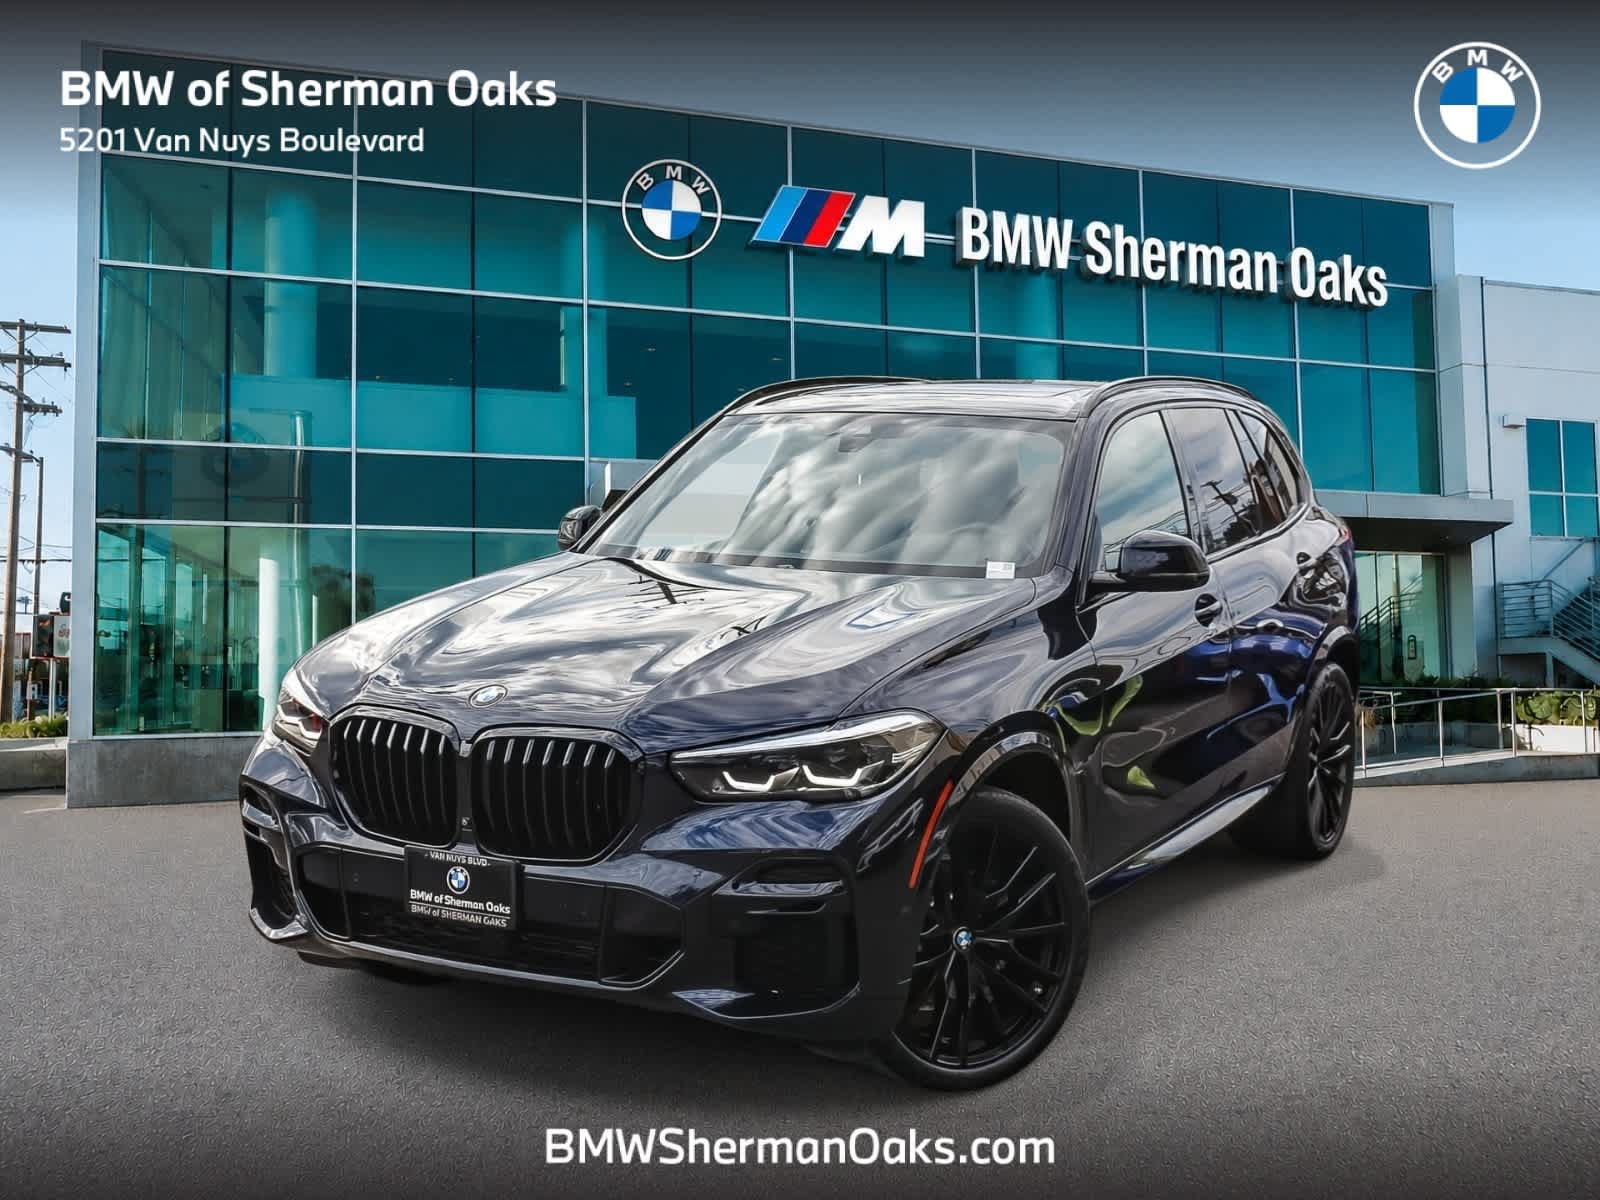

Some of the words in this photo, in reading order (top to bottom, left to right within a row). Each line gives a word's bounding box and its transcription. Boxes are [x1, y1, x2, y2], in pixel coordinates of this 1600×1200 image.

[636, 165, 711, 195] BMW
[833, 195, 925, 258] M
[959, 206, 1074, 270] BMW
[1083, 220, 1278, 294] Sherman
[1287, 247, 1389, 308] Oaks
[429, 850, 445, 861] VAN
[446, 853, 467, 864] NUYS
[410, 889, 433, 902] BMW
[434, 894, 444, 904] of
[444, 895, 485, 911] Sherman
[486, 901, 511, 914] Oaks
[411, 904, 431, 915] BMW
[432, 907, 440, 917] of
[441, 910, 482, 923] SHERMAN
